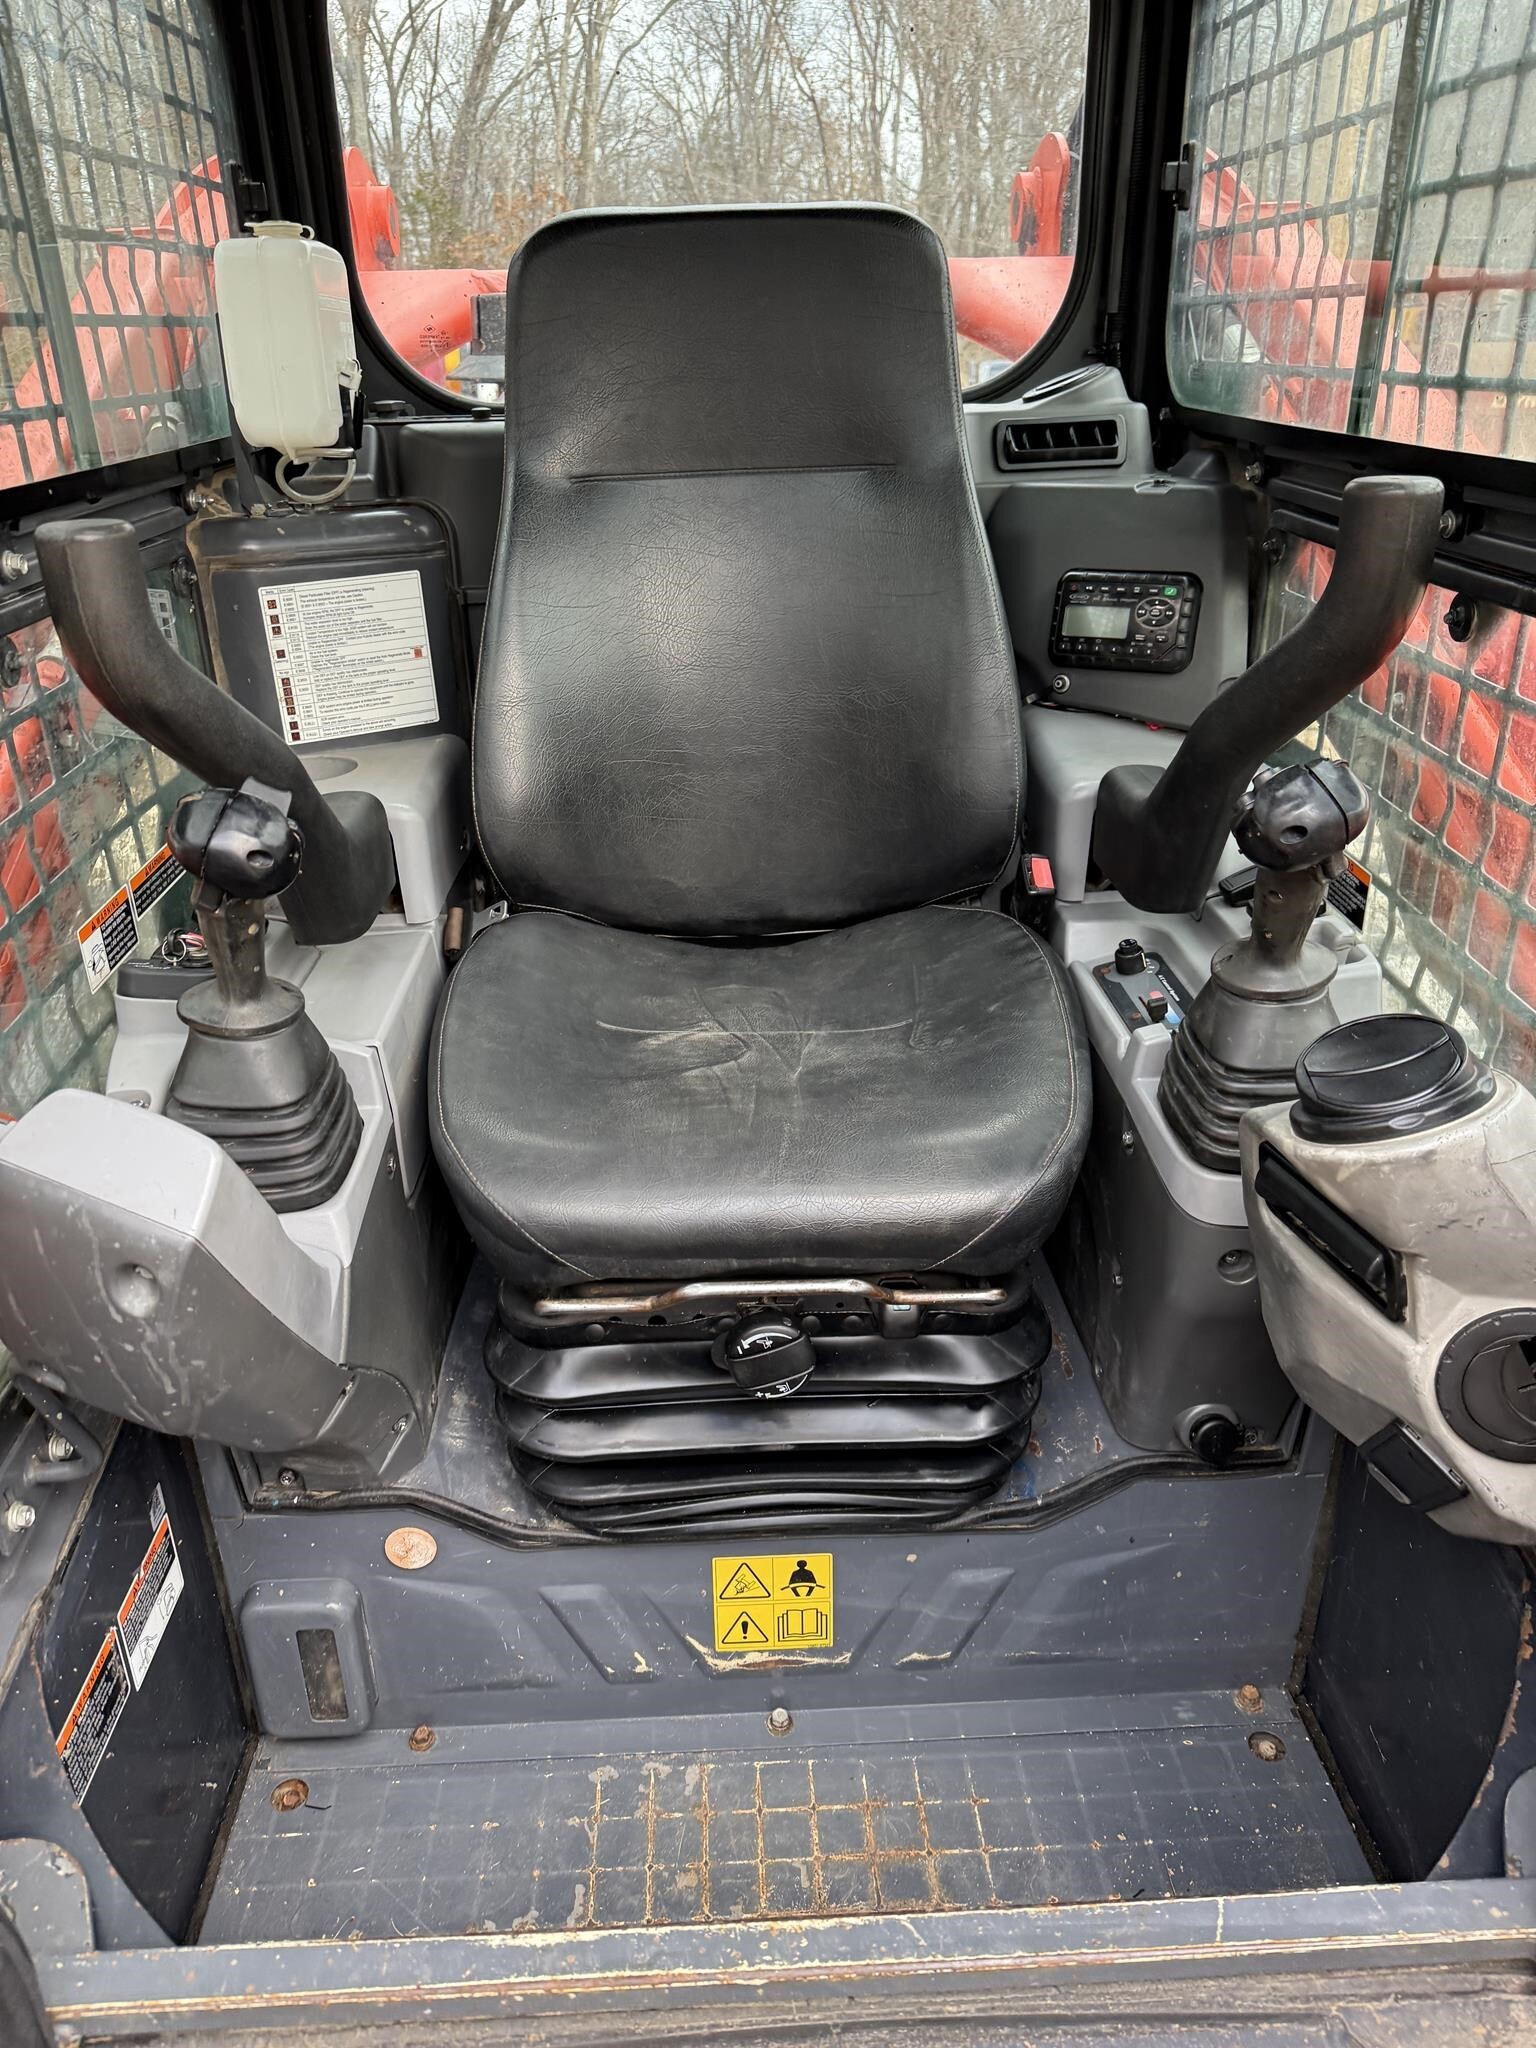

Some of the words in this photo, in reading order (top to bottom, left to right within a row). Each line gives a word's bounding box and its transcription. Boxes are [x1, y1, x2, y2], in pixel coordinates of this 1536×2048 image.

[95, 896, 119, 926] WARNING
[135, 1542, 156, 1591] WRNING
[76, 1652, 104, 1713] WARNING
